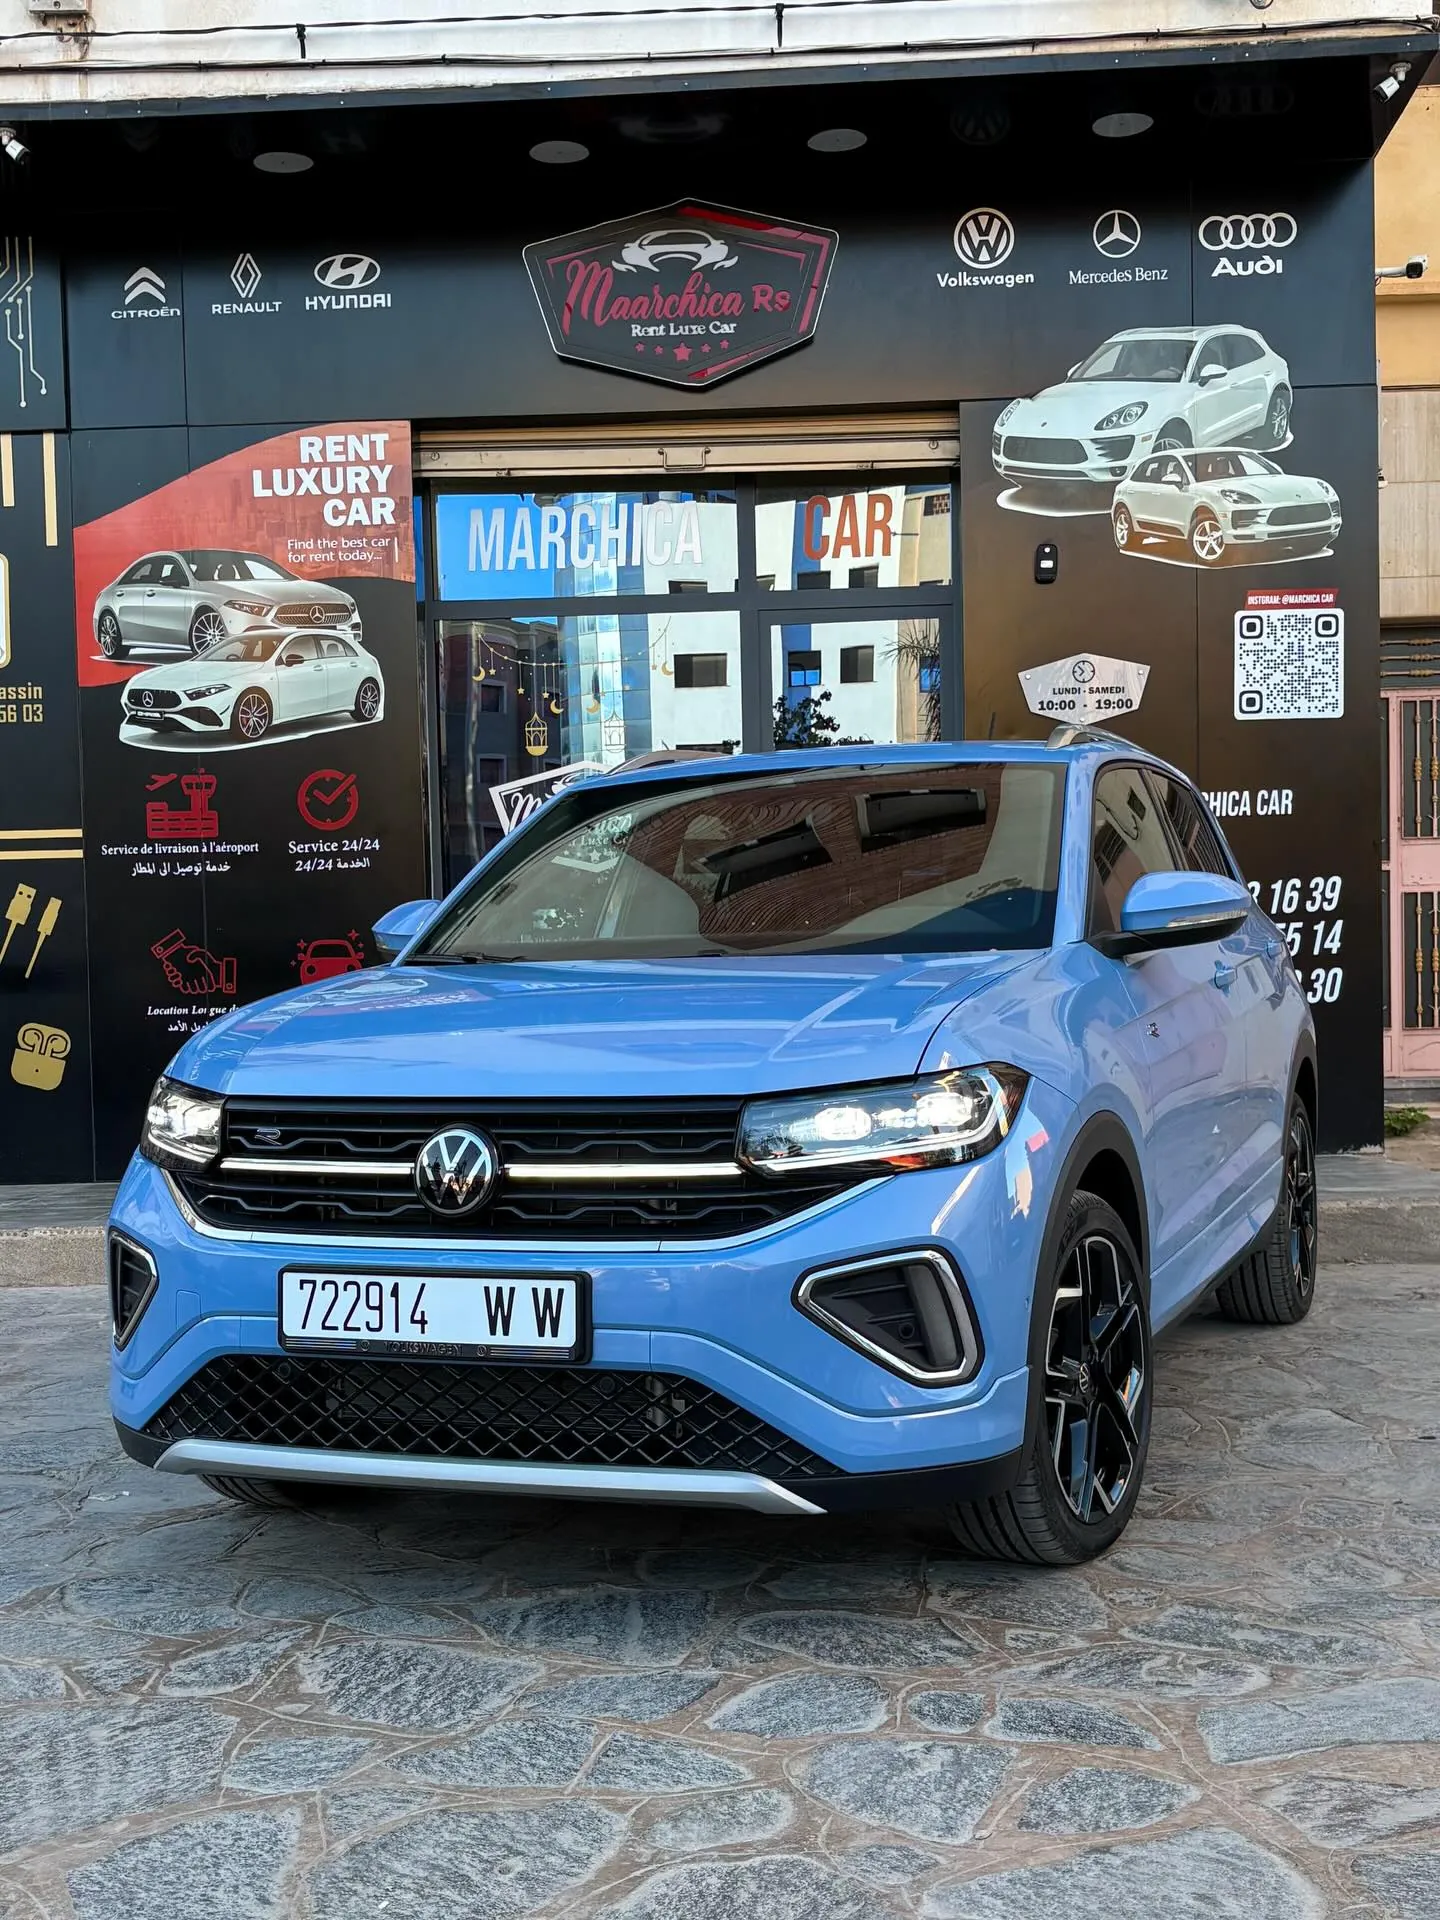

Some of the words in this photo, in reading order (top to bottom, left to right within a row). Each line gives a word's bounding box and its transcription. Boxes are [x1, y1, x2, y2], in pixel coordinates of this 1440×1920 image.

[1211, 255, 1283, 277] Audi
[937, 271, 1034, 288] Volkswagen
[1069, 267, 1132, 285] Mercedes
[1135, 267, 1168, 282] Benz
[305, 293, 391, 311] HYUNDAI
[562, 259, 744, 336] Maarchica
[752, 284, 791, 313] Rs
[111, 306, 181, 319] CITROËN
[211, 301, 282, 315] RENAULT
[631, 324, 666, 337] Rent
[669, 323, 705, 336] Luxe
[709, 321, 737, 334] Car
[300, 433, 389, 463] RENT
[253, 465, 393, 498] LUXURY
[323, 498, 396, 527] CAR
[468, 500, 704, 572] MARCHICA
[804, 493, 893, 561] CAR
[287, 538, 314, 550] Find
[317, 537, 338, 549] the
[341, 537, 368, 549] best
[371, 538, 391, 547] car
[288, 551, 306, 563] for
[309, 551, 334, 562] rent
[338, 550, 382, 562] today...
[1321, 593, 1334, 603] CAR
[1052, 687, 1081, 695] LUNDI
[1088, 686, 1125, 694] SAMEDI
[23, 703, 43, 722] 03
[1038, 700, 1076, 711] 10:00
[1095, 698, 1133, 709] 19:00
[1256, 789, 1293, 815] CAR
[101, 844, 138, 855] Service
[141, 843, 153, 854] de
[155, 843, 199, 854] livraison
[202, 842, 208, 853] à
[210, 841, 259, 855] l'aéroport
[288, 840, 338, 854] Service
[342, 837, 380, 851] 24/24
[132, 862, 156, 876] المطار
[173, 861, 202, 876] توصيل
[205, 861, 231, 872] خدمة
[295, 858, 333, 872] 24/24
[336, 857, 370, 868] الخدمة
[1270, 878, 1301, 914] 16
[1305, 875, 1342, 912] 39
[1313, 919, 1343, 955] 14
[1306, 967, 1343, 1004] 30
[147, 1006, 188, 1016] Location
[299, 1278, 428, 1334] 722914
